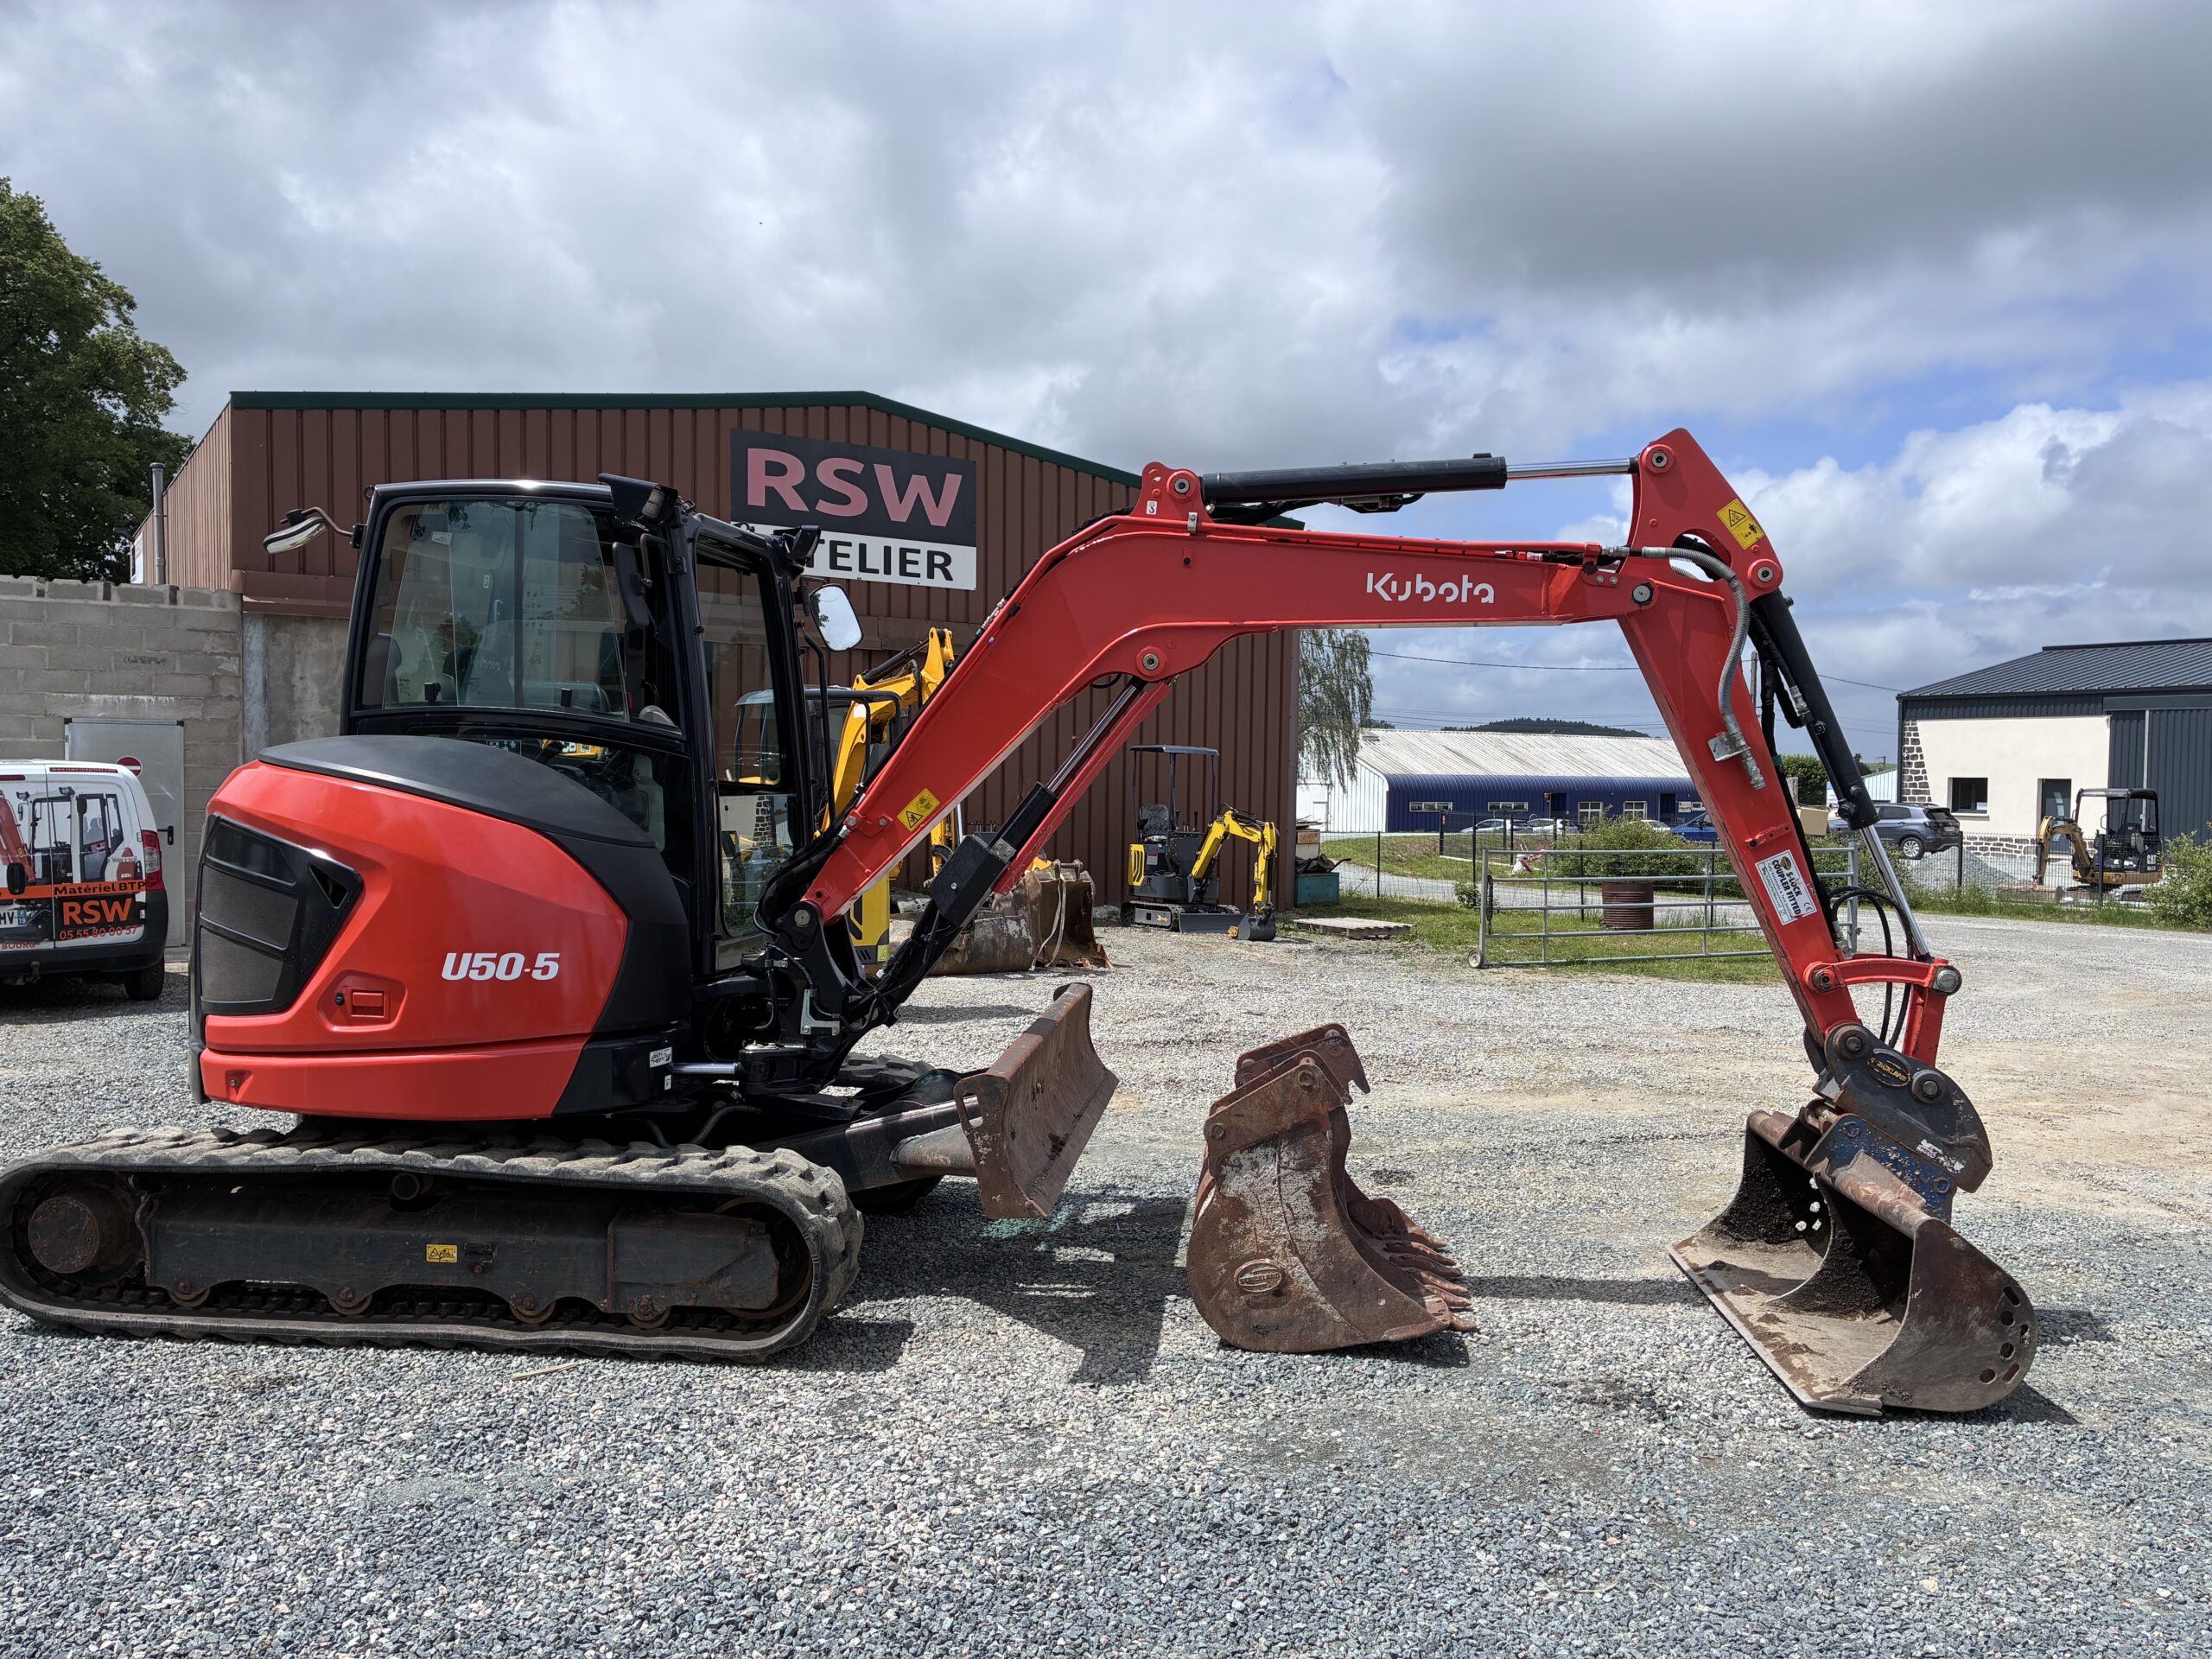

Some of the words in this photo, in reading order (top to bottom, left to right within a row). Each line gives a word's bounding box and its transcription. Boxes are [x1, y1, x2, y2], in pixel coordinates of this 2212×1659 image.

[747, 448, 963, 527] RSW
[1366, 572, 1494, 603] Kubota
[54, 882, 116, 895] Matériel
[118, 881, 146, 892] BTP
[1772, 860, 1790, 891] COUPLER
[1787, 890, 1802, 915] FITTED
[1786, 872, 1802, 897] S-LOCK
[62, 898, 132, 925] RSW
[60, 931, 73, 940] 05
[109, 927, 123, 936] 00
[441, 952, 560, 981] U50-5
